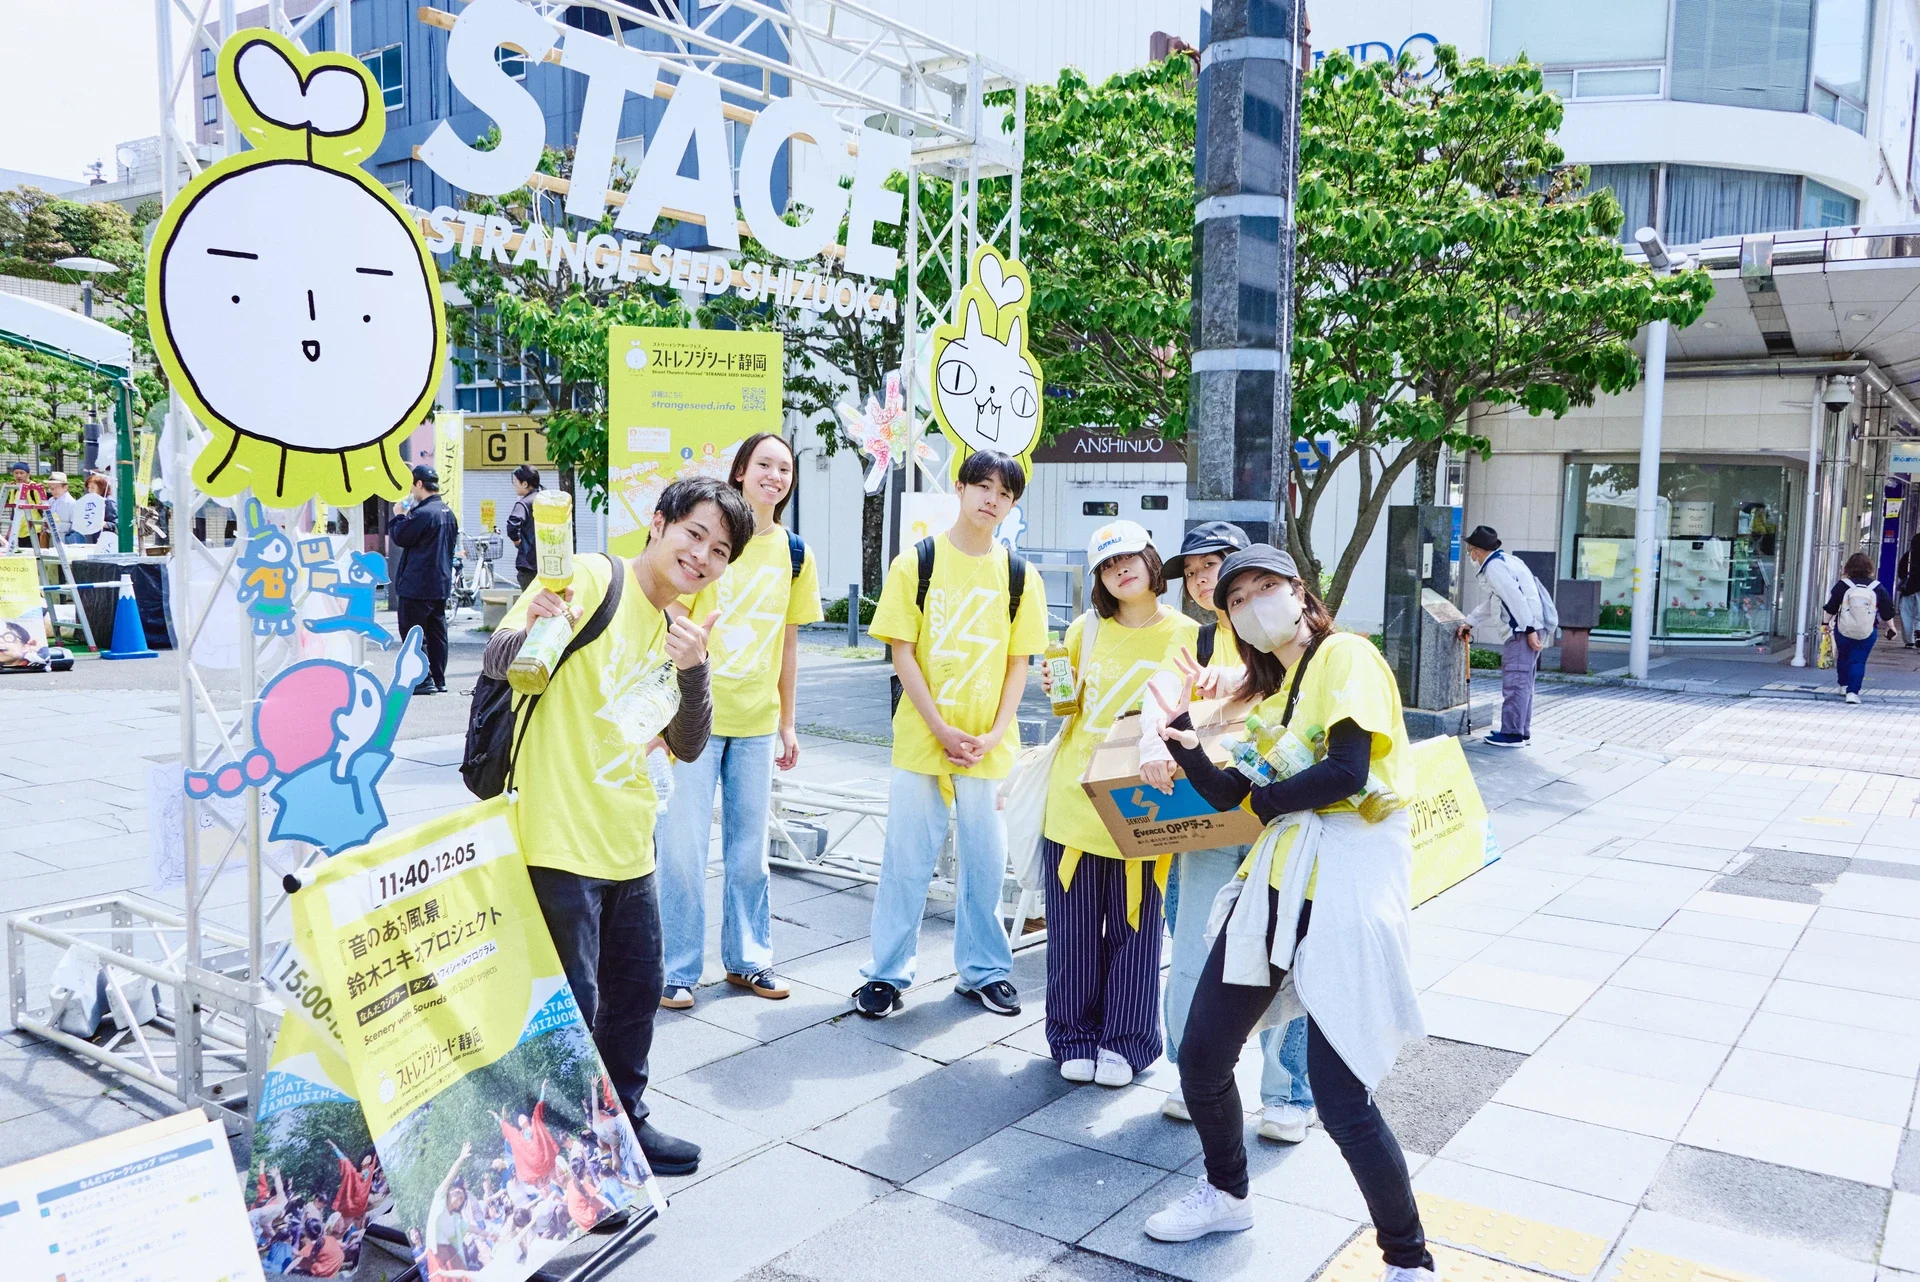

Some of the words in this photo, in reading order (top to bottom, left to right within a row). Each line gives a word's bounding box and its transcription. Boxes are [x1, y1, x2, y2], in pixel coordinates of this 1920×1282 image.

[418, 0, 912, 281] STAGE
[426, 205, 643, 284] STRANGE
[647, 245, 733, 296] SEED
[739, 260, 897, 325] SHIZUOKA
[652, 347, 767, 372] ストレンジシード静岡
[651, 401, 736, 412] strangeseed.info
[1073, 437, 1164, 454] ANSHINDO
[929, 588, 945, 638] 2025
[1125, 816, 1151, 826] SEKISUI
[379, 842, 476, 900] 11:40-12:05
[364, 1021, 396, 1046] Scenery
[397, 1008, 412, 1025] with
[413, 994, 448, 1014] Sounds
